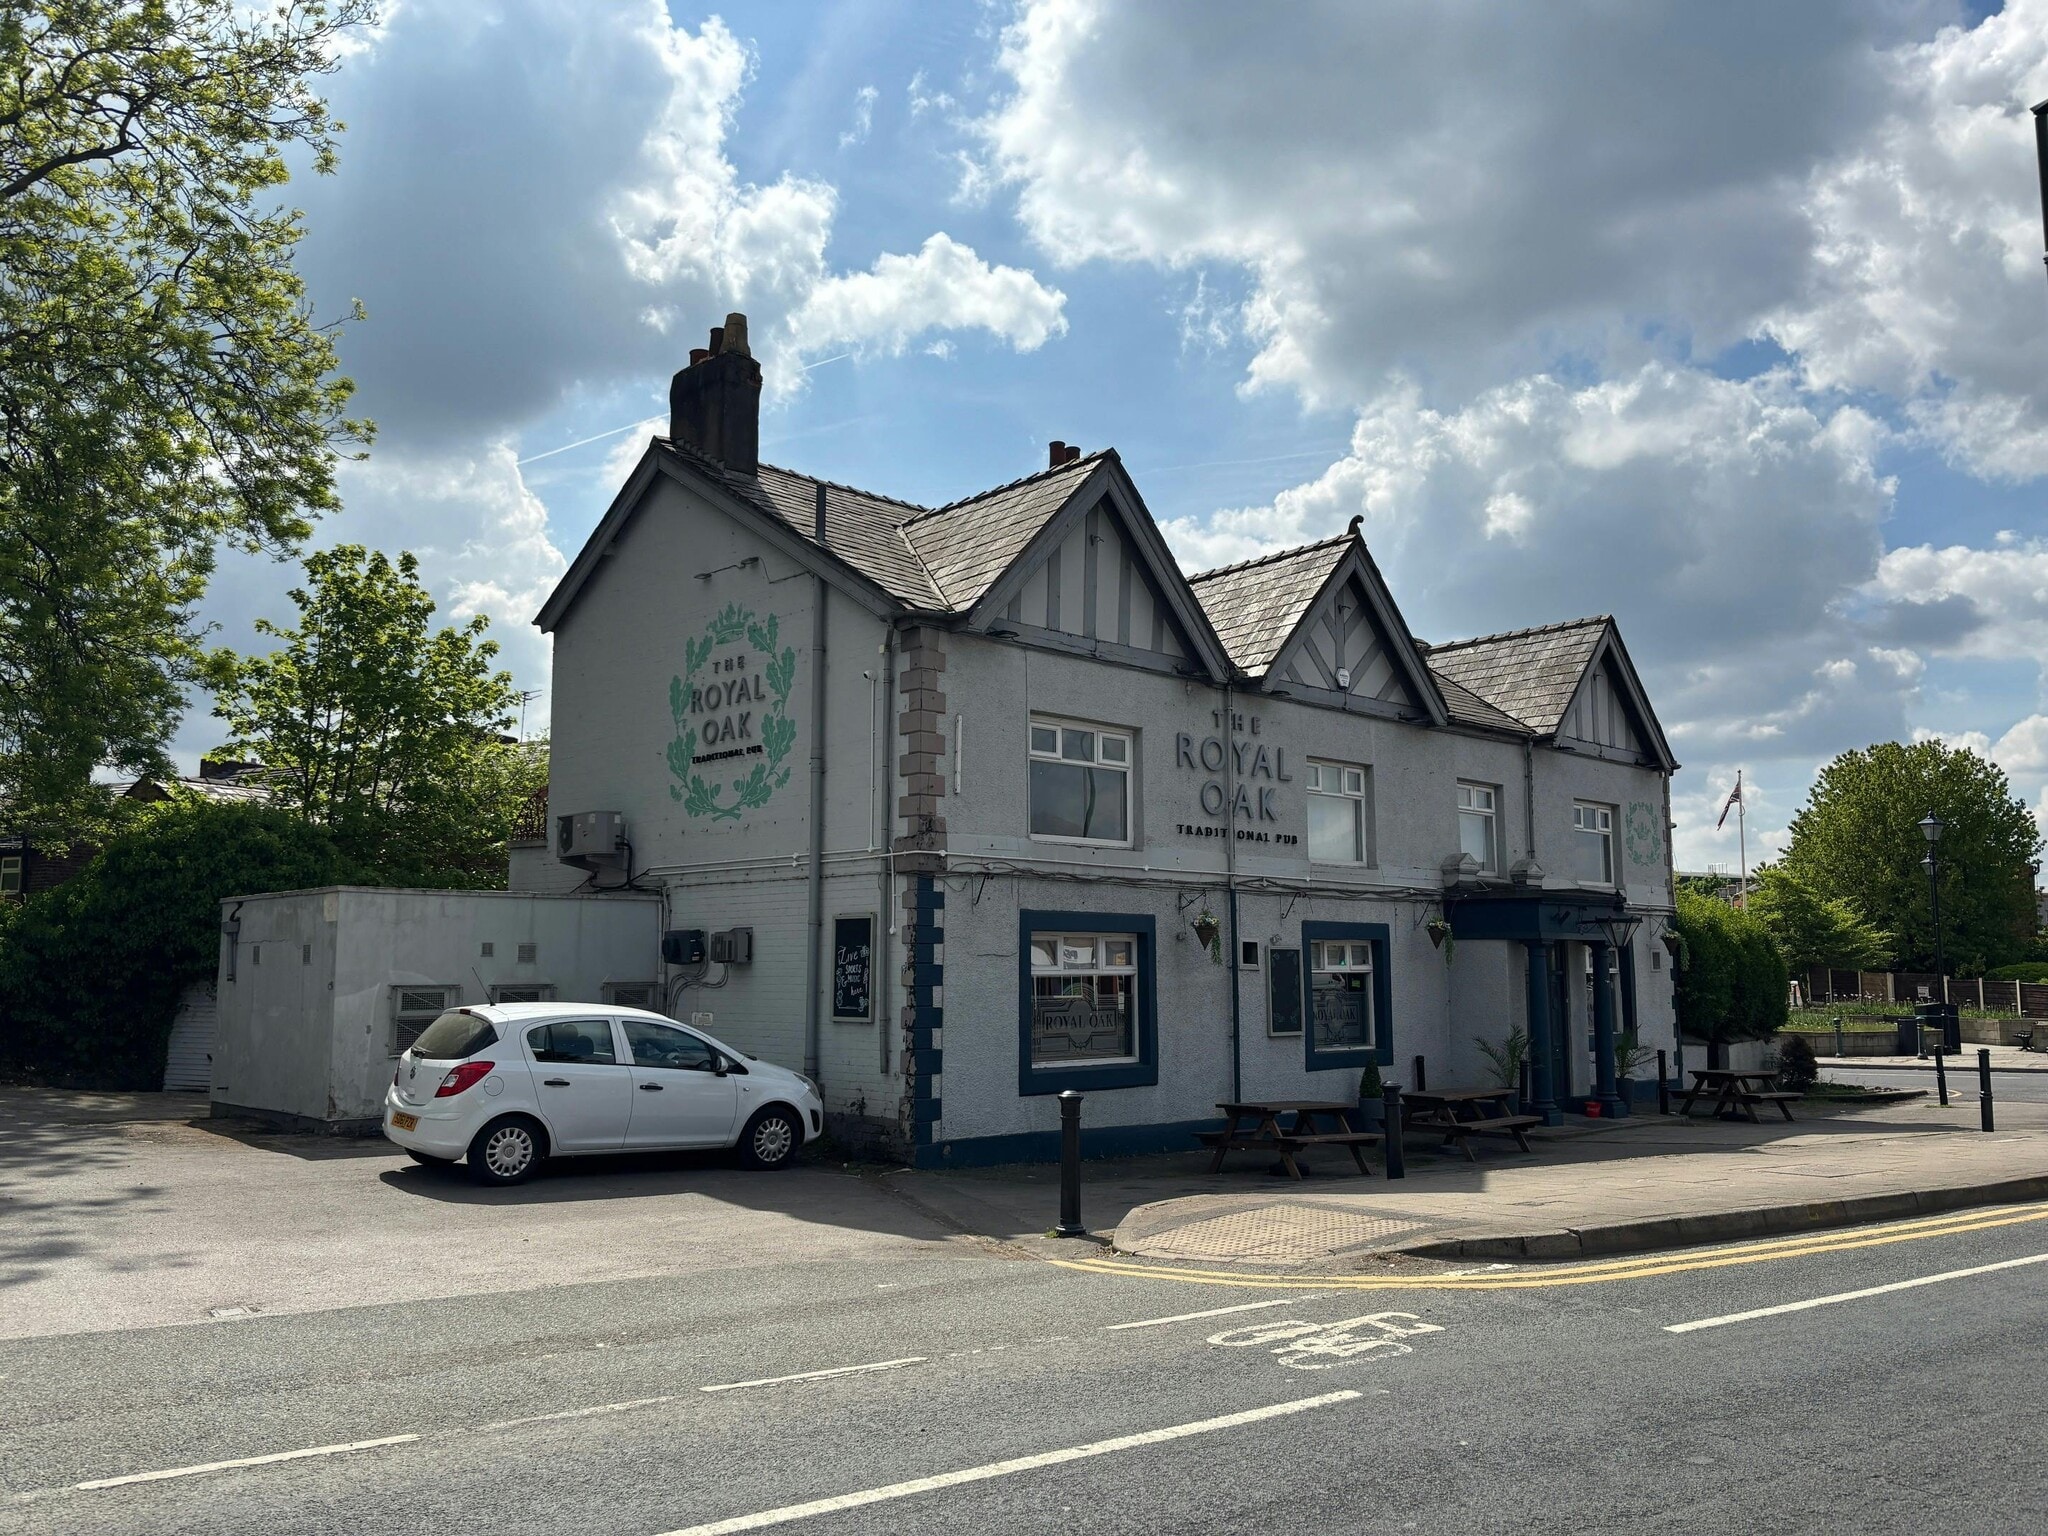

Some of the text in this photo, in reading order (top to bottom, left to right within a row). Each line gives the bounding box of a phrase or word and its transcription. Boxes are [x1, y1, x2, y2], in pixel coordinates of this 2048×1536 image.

[712, 655, 745, 674] THE
[690, 674, 766, 714] ROYAL
[702, 711, 751, 745] OAK
[1211, 709, 1262, 735] THE
[691, 744, 763, 764] TRADITIONAL PUB
[1176, 731, 1293, 782] ROYAL
[1201, 779, 1279, 822] OAK
[1177, 823, 1298, 845] TRADITONAL PUB
[838, 946, 858, 965] Live
[1046, 1013, 1113, 1030] ROYAL OAK
